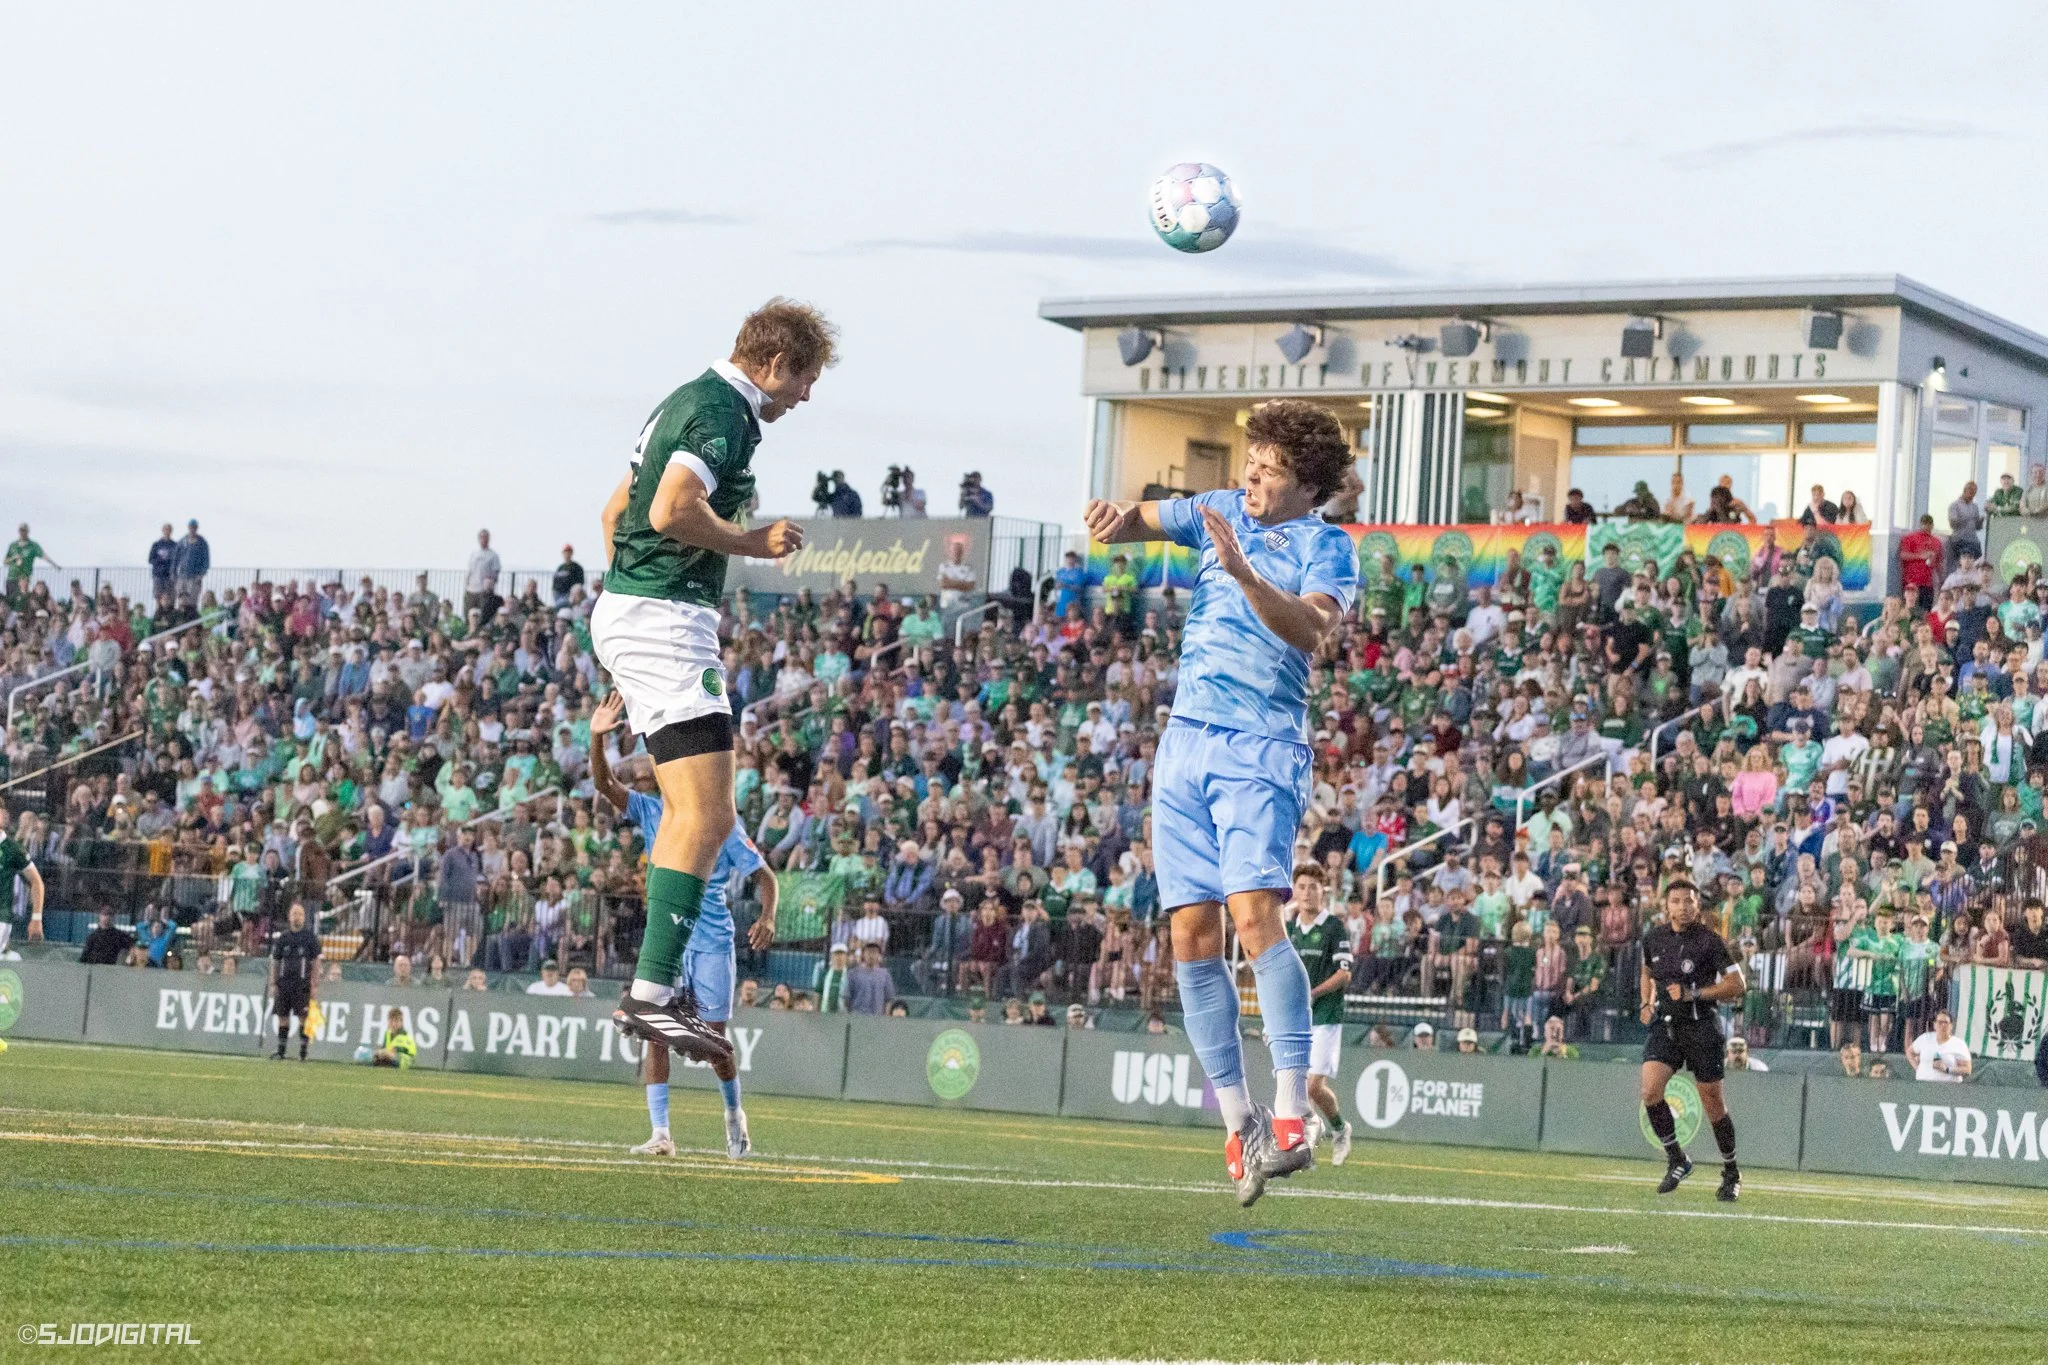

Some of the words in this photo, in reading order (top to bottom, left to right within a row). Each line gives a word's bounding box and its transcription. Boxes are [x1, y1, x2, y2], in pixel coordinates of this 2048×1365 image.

[1140, 363, 1328, 390] UNIVERSITY
[1361, 362, 1392, 388] OF
[1426, 358, 1573, 385] VERMONT
[1601, 352, 1827, 383] CATAMOUNTS
[783, 538, 930, 586] Undefeated
[156, 988, 350, 1044] EVERYE
[447, 1009, 475, 1052] A
[485, 1011, 587, 1060] PART
[1111, 1050, 1203, 1107] USL
[1412, 1079, 1448, 1098] FOR
[1450, 1081, 1483, 1100] THE
[1410, 1096, 1481, 1117] PLANET
[1878, 1101, 2048, 1162] VERM
